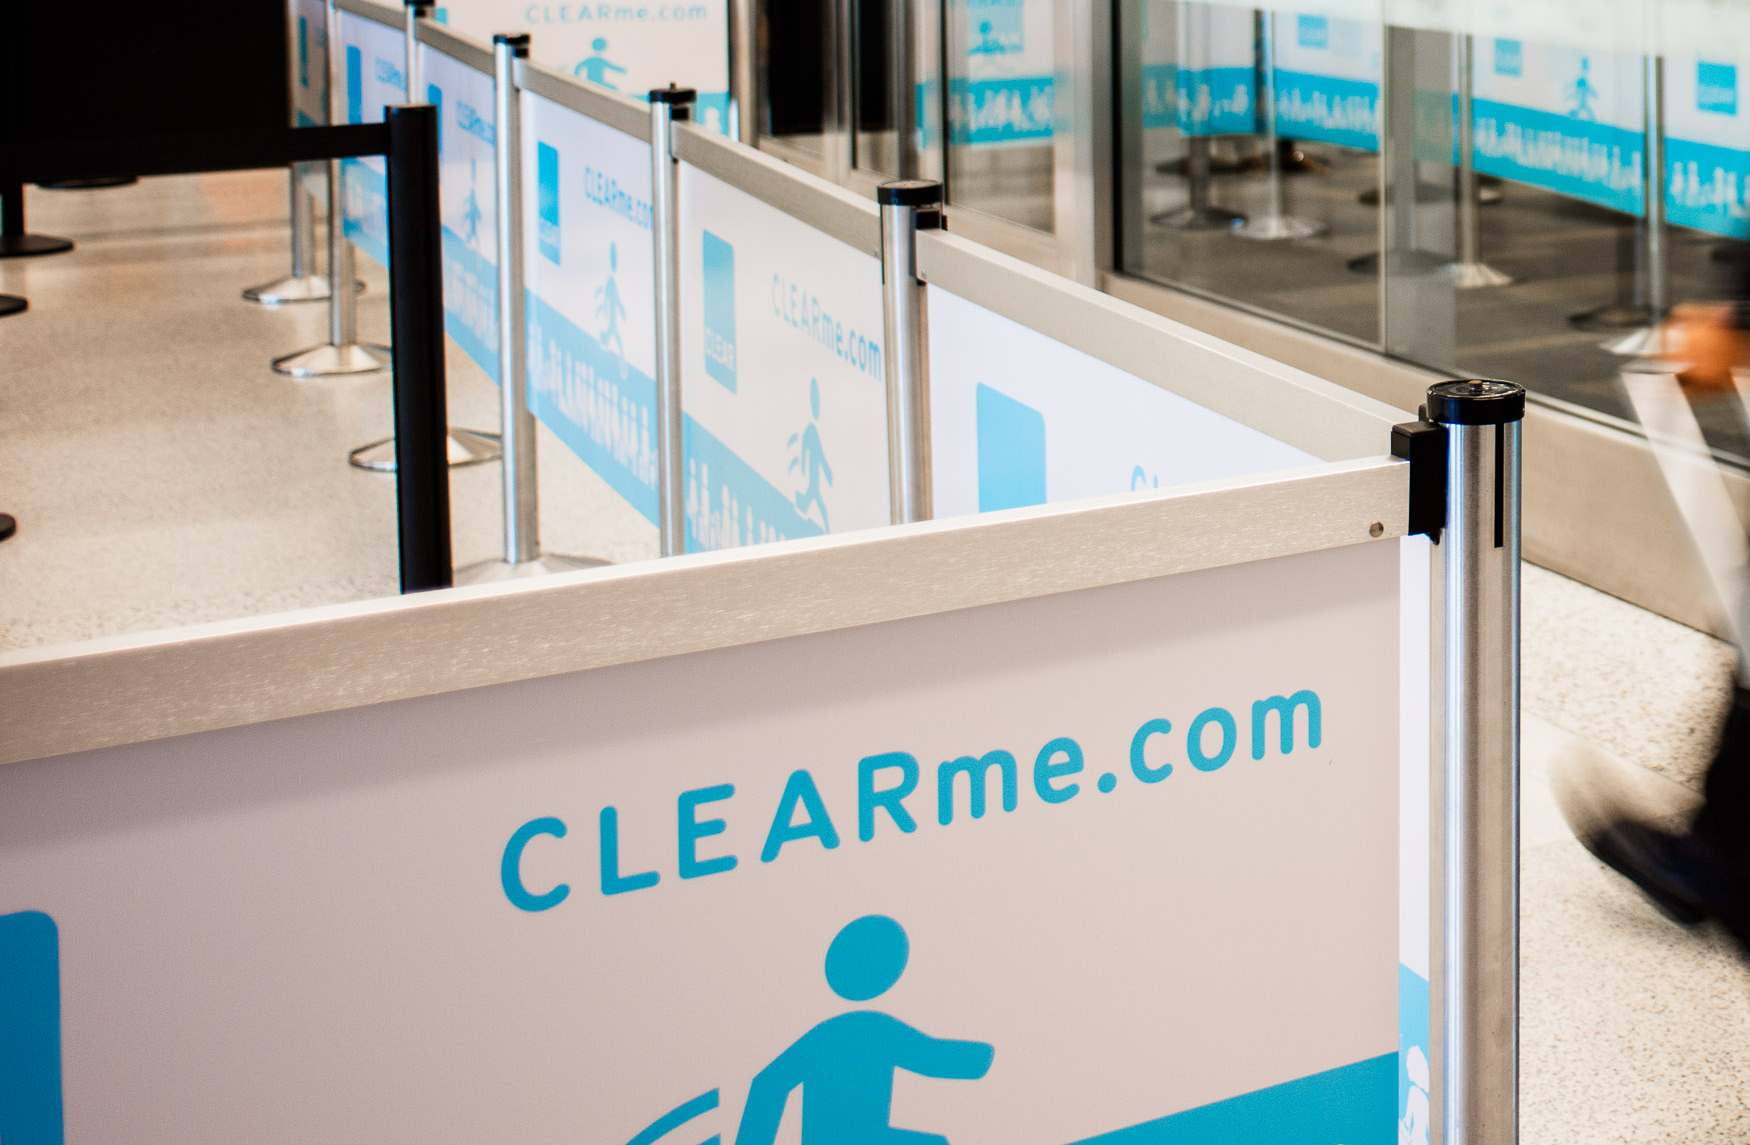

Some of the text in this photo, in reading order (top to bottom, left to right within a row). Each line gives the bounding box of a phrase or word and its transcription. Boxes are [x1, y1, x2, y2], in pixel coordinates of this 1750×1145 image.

[525, 4, 707, 23] CLEARme.com
[772, 272, 882, 383] CLEARme.com
[500, 689, 1322, 913] CLEARme.com
